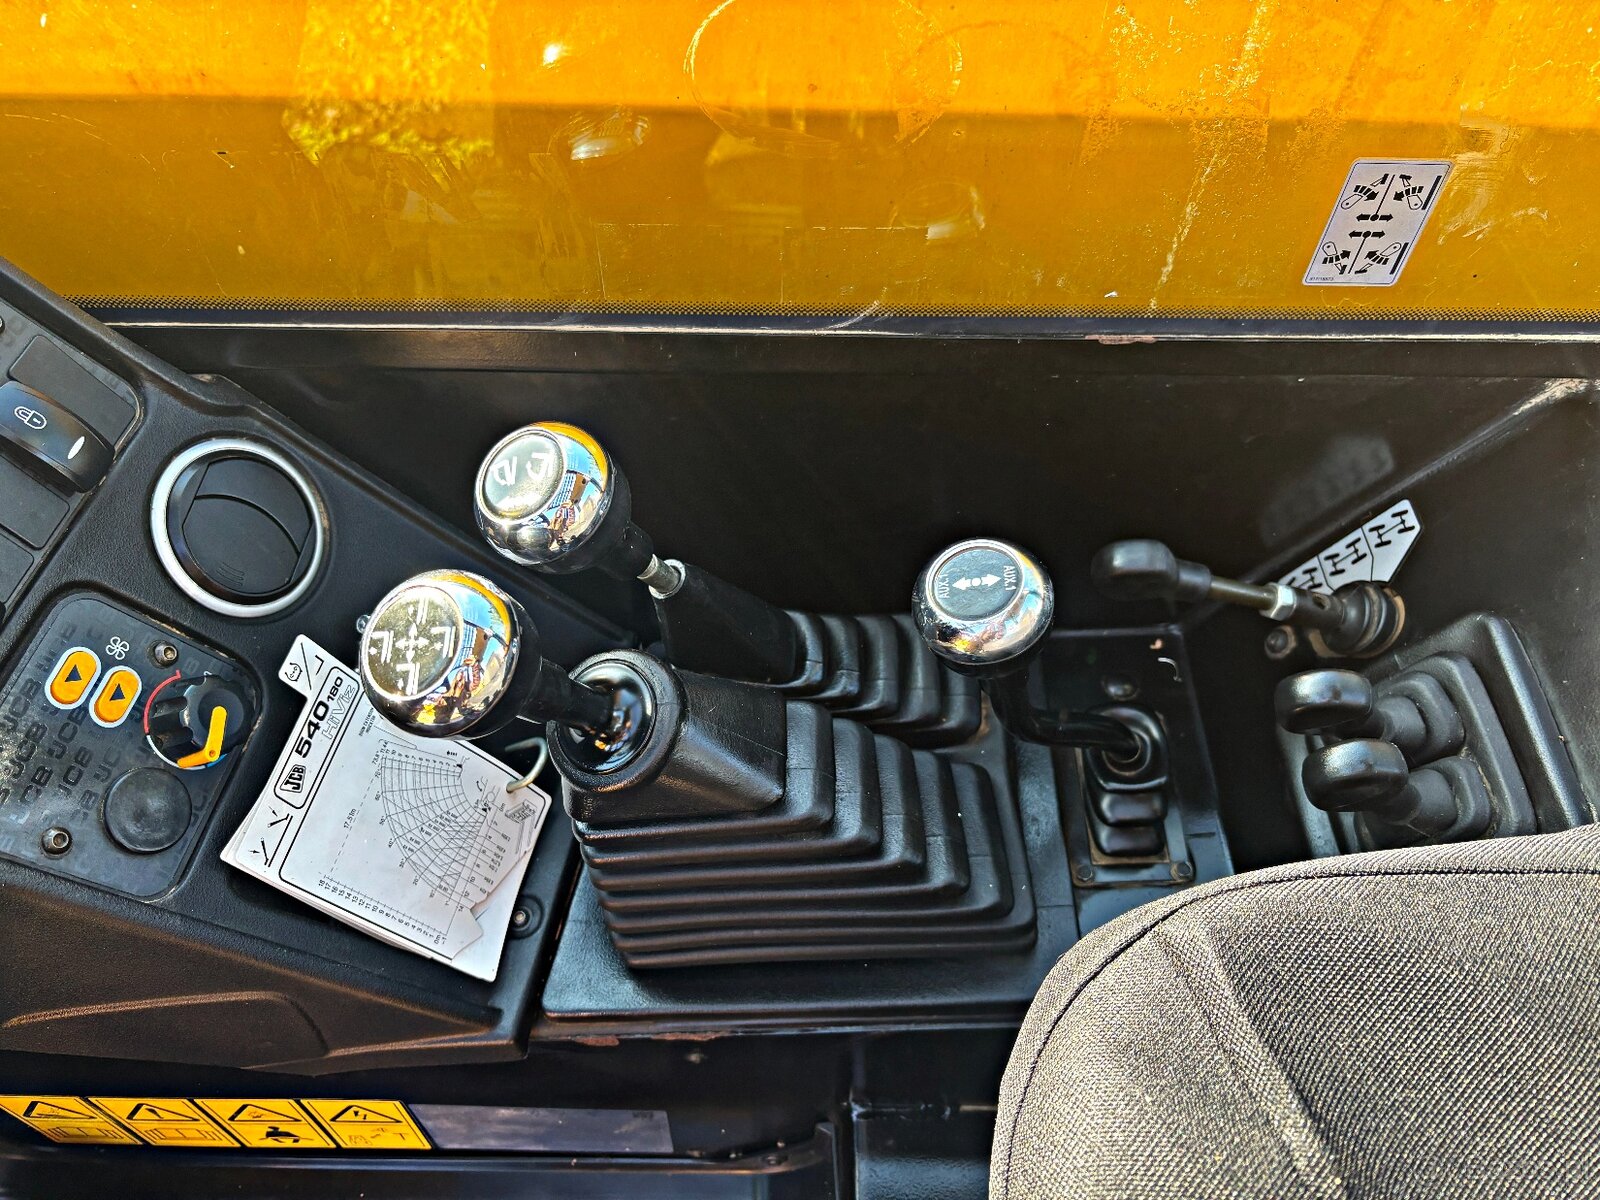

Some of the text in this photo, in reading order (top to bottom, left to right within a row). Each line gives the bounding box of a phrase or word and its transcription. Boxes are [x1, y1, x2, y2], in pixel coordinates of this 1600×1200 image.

[1003, 565, 1017, 592] AUX.1
[47, 706, 89, 760] JCB
[283, 676, 344, 792] JCB 540 180
[321, 685, 356, 740] HiViz
[9, 721, 48, 780] JCB
